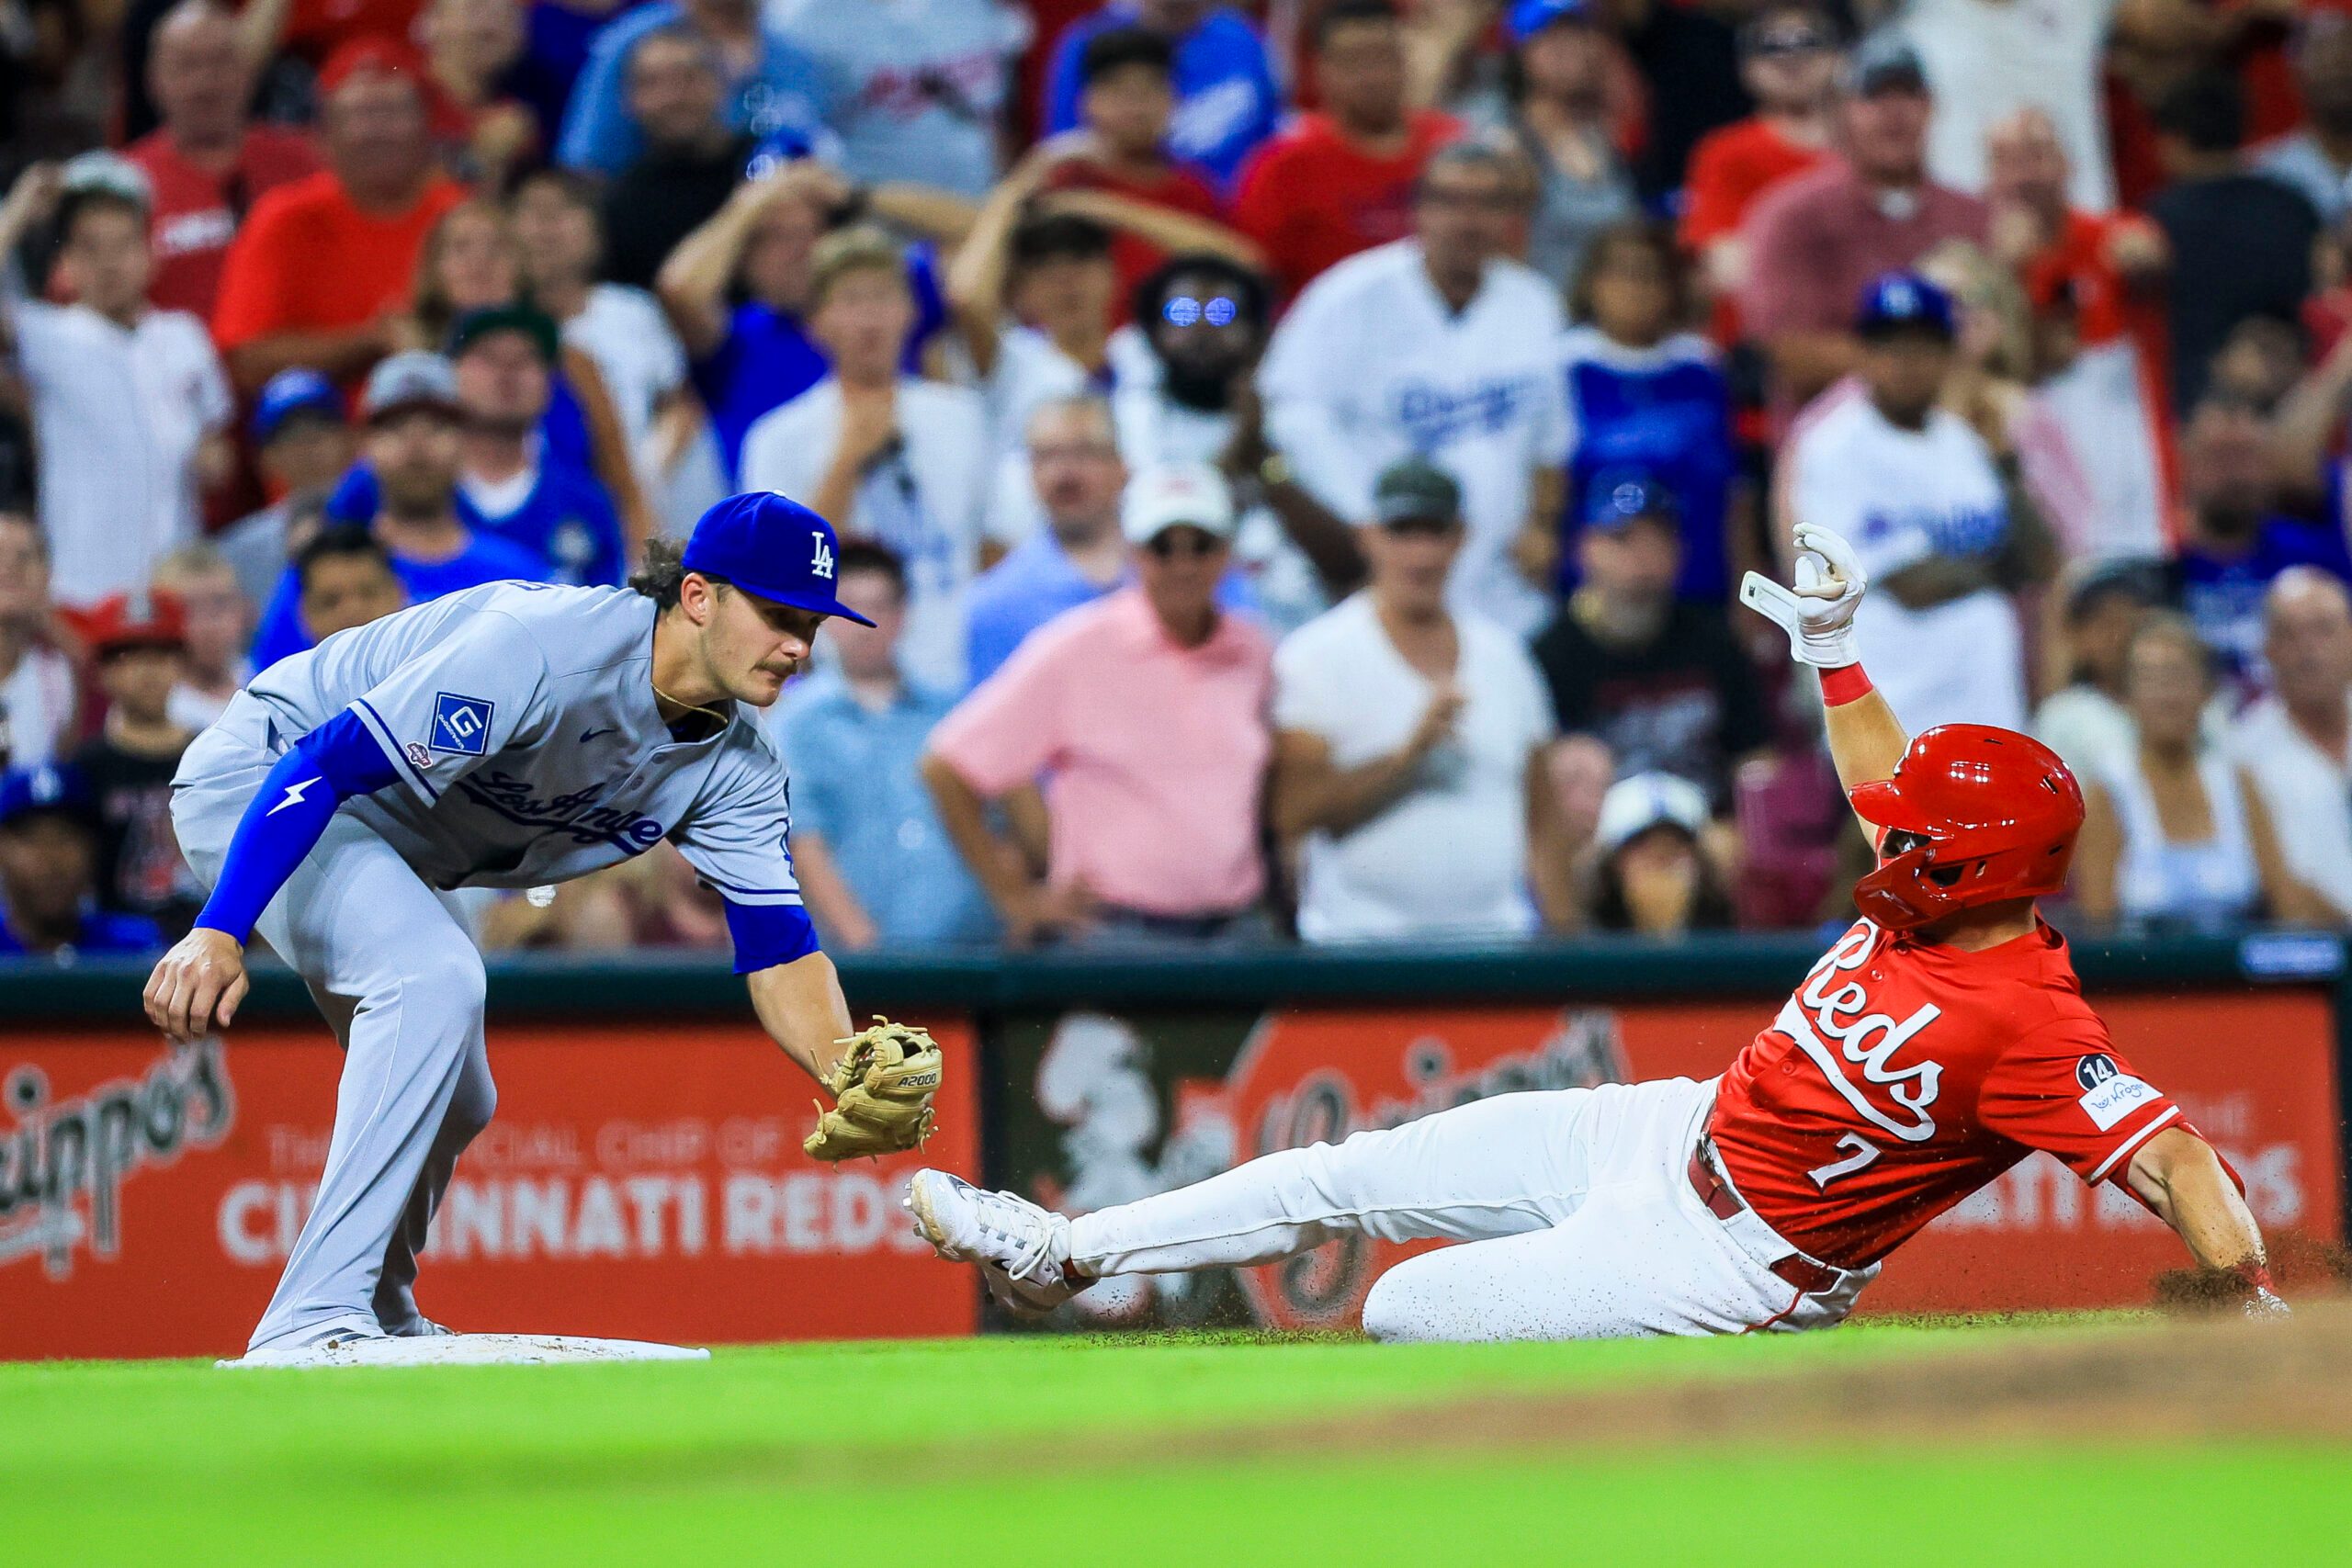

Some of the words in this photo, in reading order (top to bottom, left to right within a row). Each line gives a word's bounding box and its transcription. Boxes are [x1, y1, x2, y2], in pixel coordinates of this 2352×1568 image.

[811, 531, 834, 580] LA
[449, 705, 483, 738] G
[466, 770, 546, 816] Los
[1796, 916, 1944, 1142] Reds
[897, 1072, 937, 1087] A2000
[2083, 1057, 2114, 1088] 14
[1805, 1130, 1883, 1192] 7
